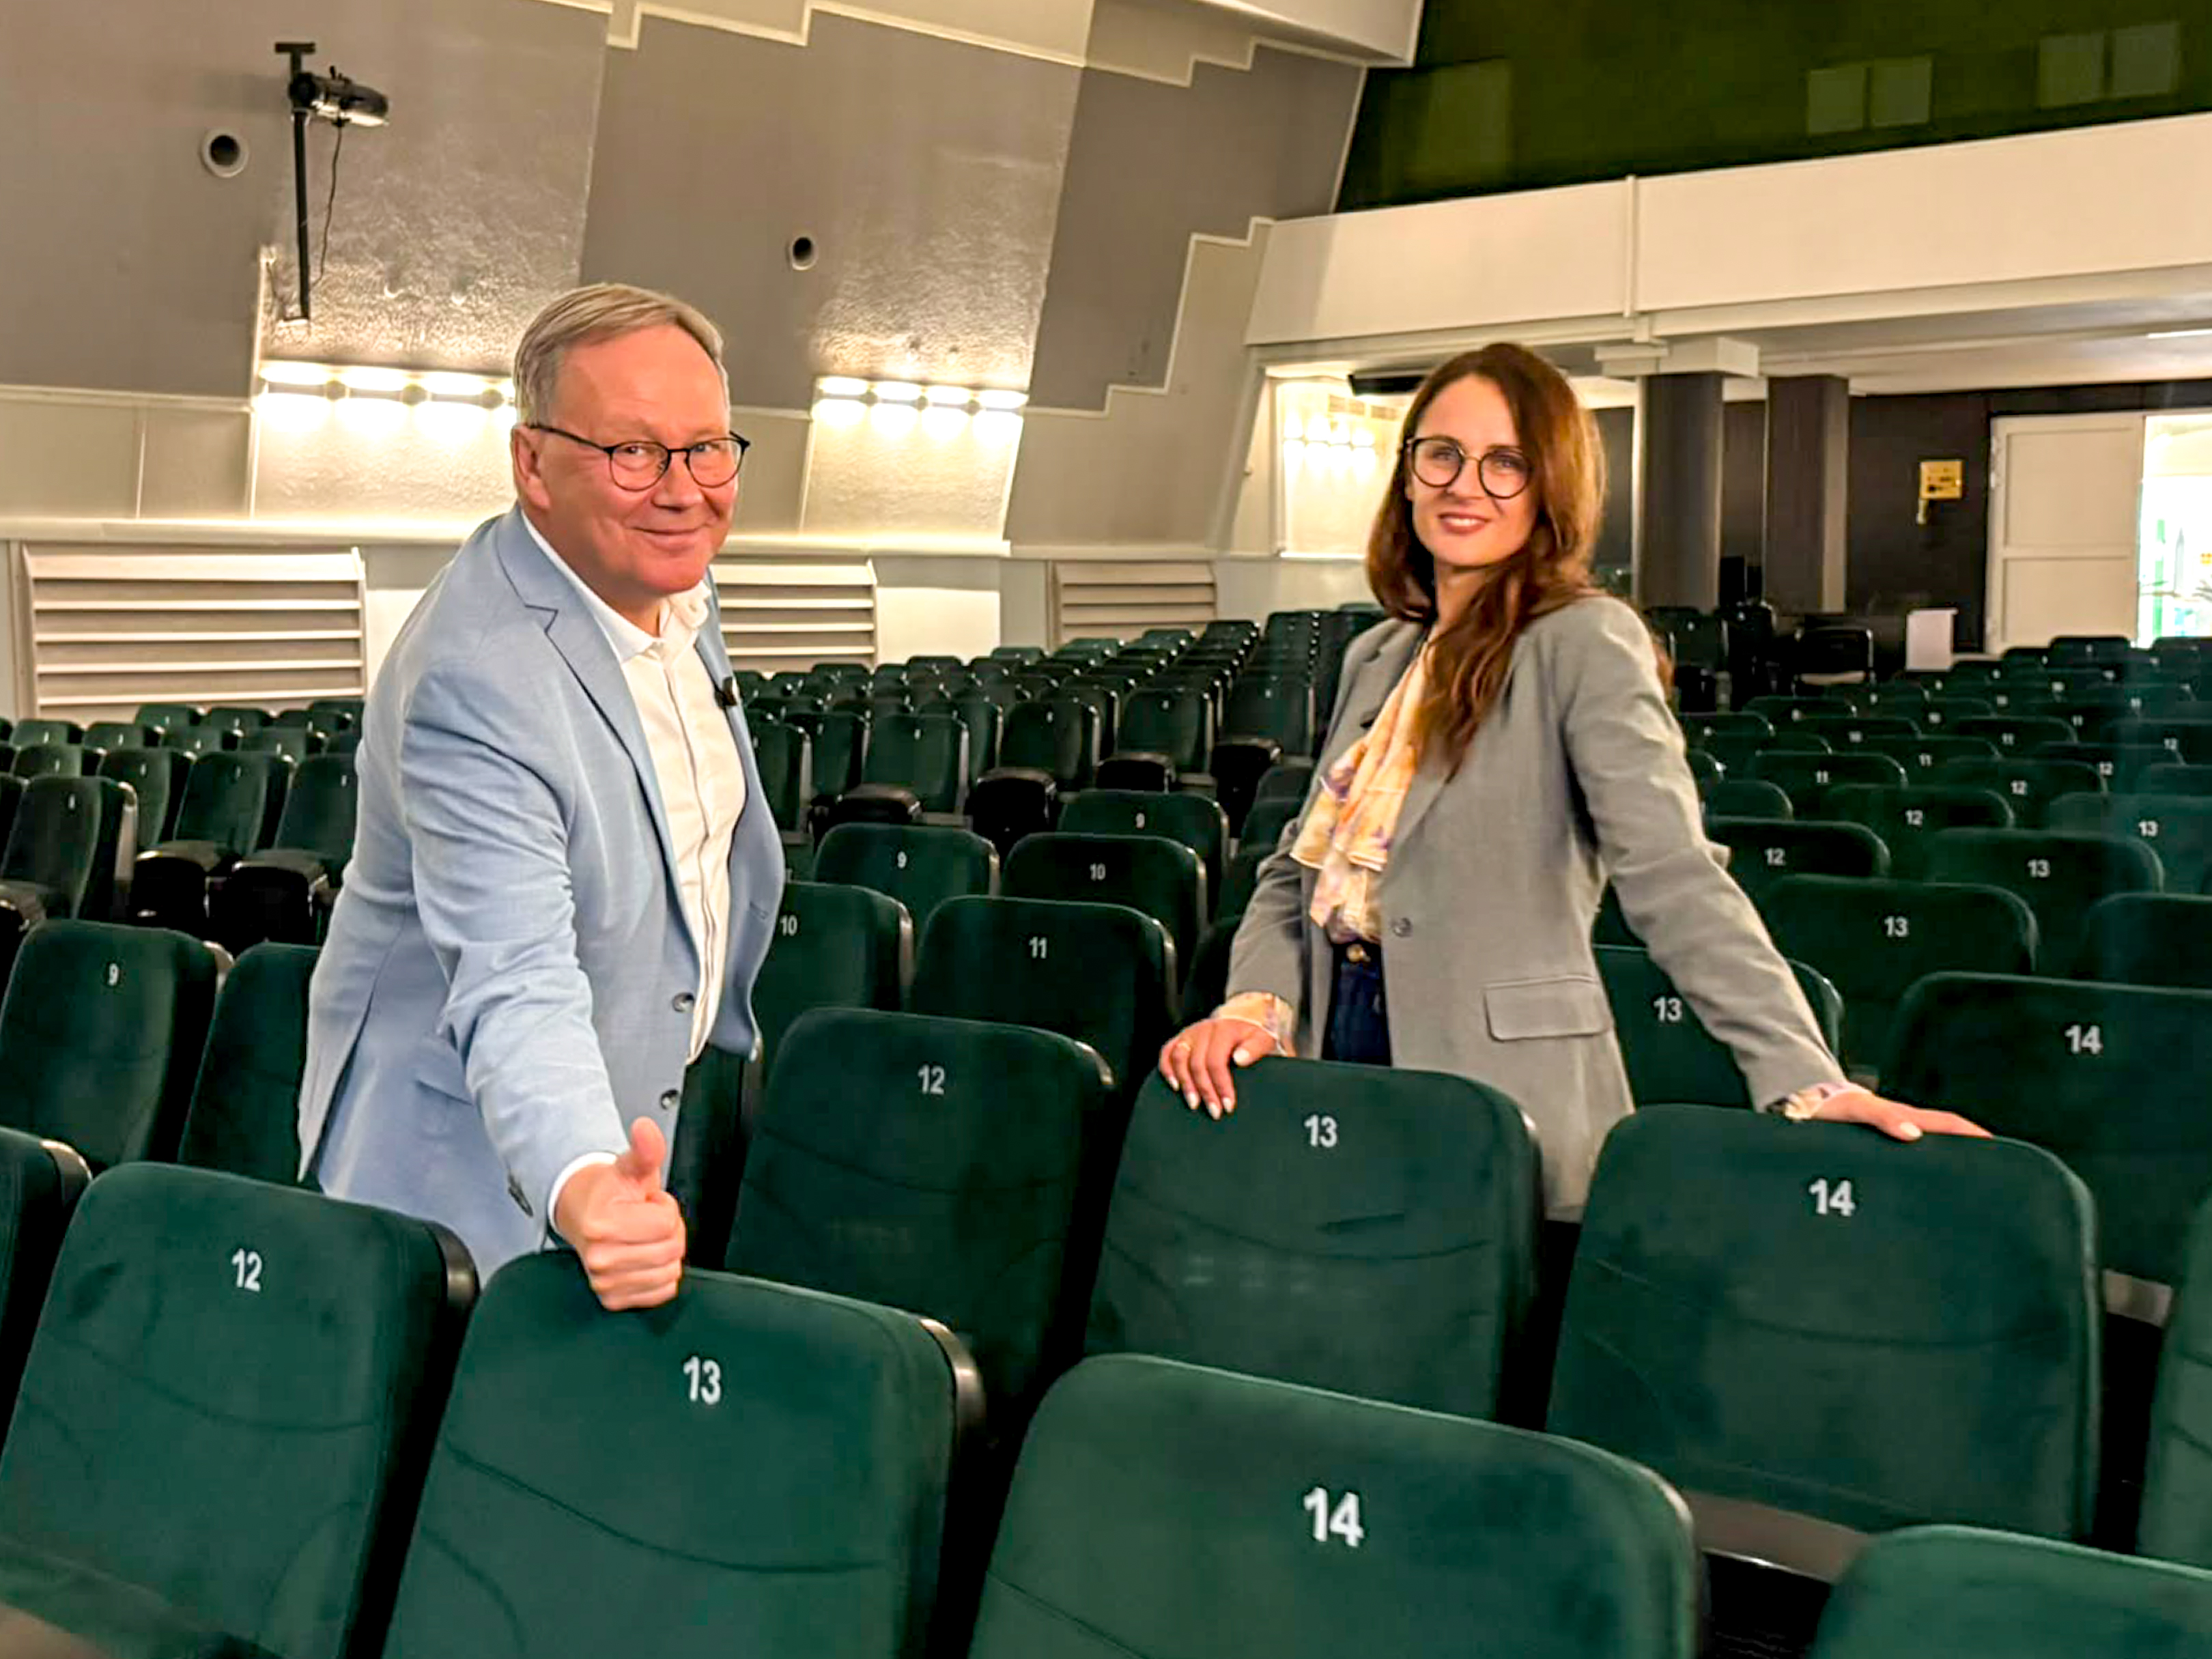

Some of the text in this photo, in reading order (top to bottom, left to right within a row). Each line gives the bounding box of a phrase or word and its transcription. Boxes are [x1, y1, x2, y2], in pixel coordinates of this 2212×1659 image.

[1918, 753, 1931, 767] 11
[1815, 770, 1829, 784] 11
[2011, 780, 2028, 796] 12
[1905, 809, 1923, 826] 12
[2138, 820, 2159, 837] 13
[897, 851, 907, 868] 9
[1765, 847, 1785, 866] 12
[1090, 863, 1106, 881] 10
[2027, 859, 2050, 878] 13
[780, 915, 797, 936] 10
[1884, 916, 1909, 937] 13
[1029, 937, 1047, 959] 11
[108, 963, 119, 986] 9
[1653, 996, 1683, 1022] 13
[2064, 1025, 2103, 1055] 14
[918, 1065, 945, 1095] 12
[1304, 1114, 1338, 1148] 13
[1809, 1179, 1856, 1217] 14
[232, 1249, 263, 1292] 12
[683, 1357, 722, 1406] 13
[1303, 1487, 1364, 1548] 14
